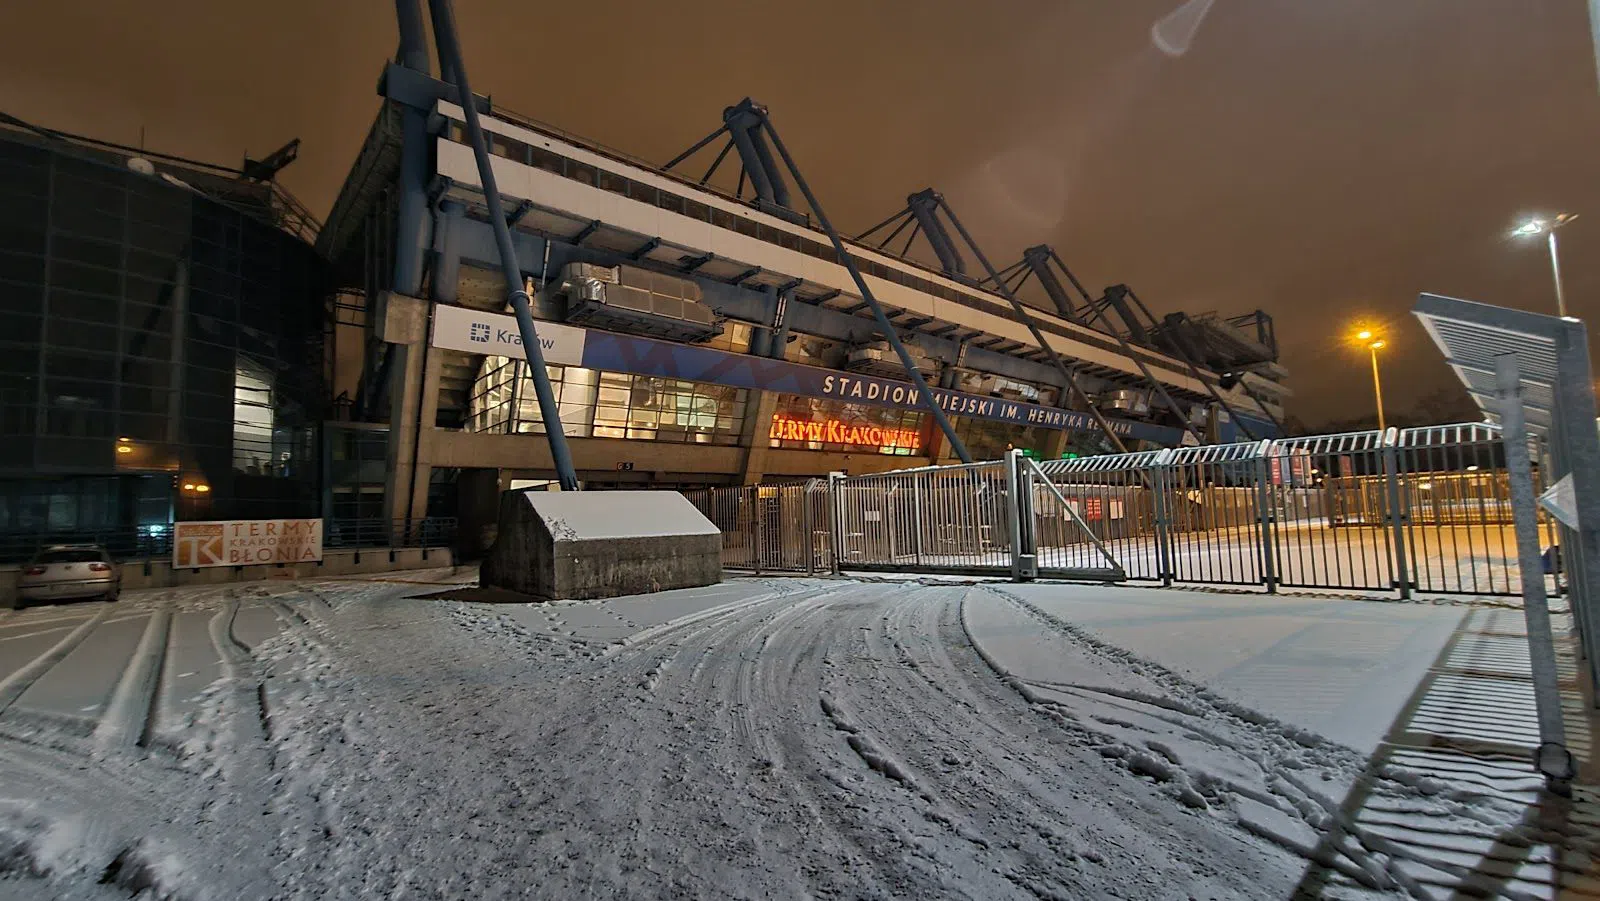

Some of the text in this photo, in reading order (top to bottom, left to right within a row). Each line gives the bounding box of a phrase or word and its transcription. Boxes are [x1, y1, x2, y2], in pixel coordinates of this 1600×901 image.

[497, 329, 555, 350] Kraw
[823, 375, 919, 405] STADION
[1000, 404, 1021, 420] IM.
[1028, 408, 1082, 428] HENRYKA
[1086, 417, 1132, 435] REMANA
[231, 521, 317, 537] TERMY
[230, 536, 316, 547] KRAKOWSKIE
[230, 547, 316, 564] BŁONIA
